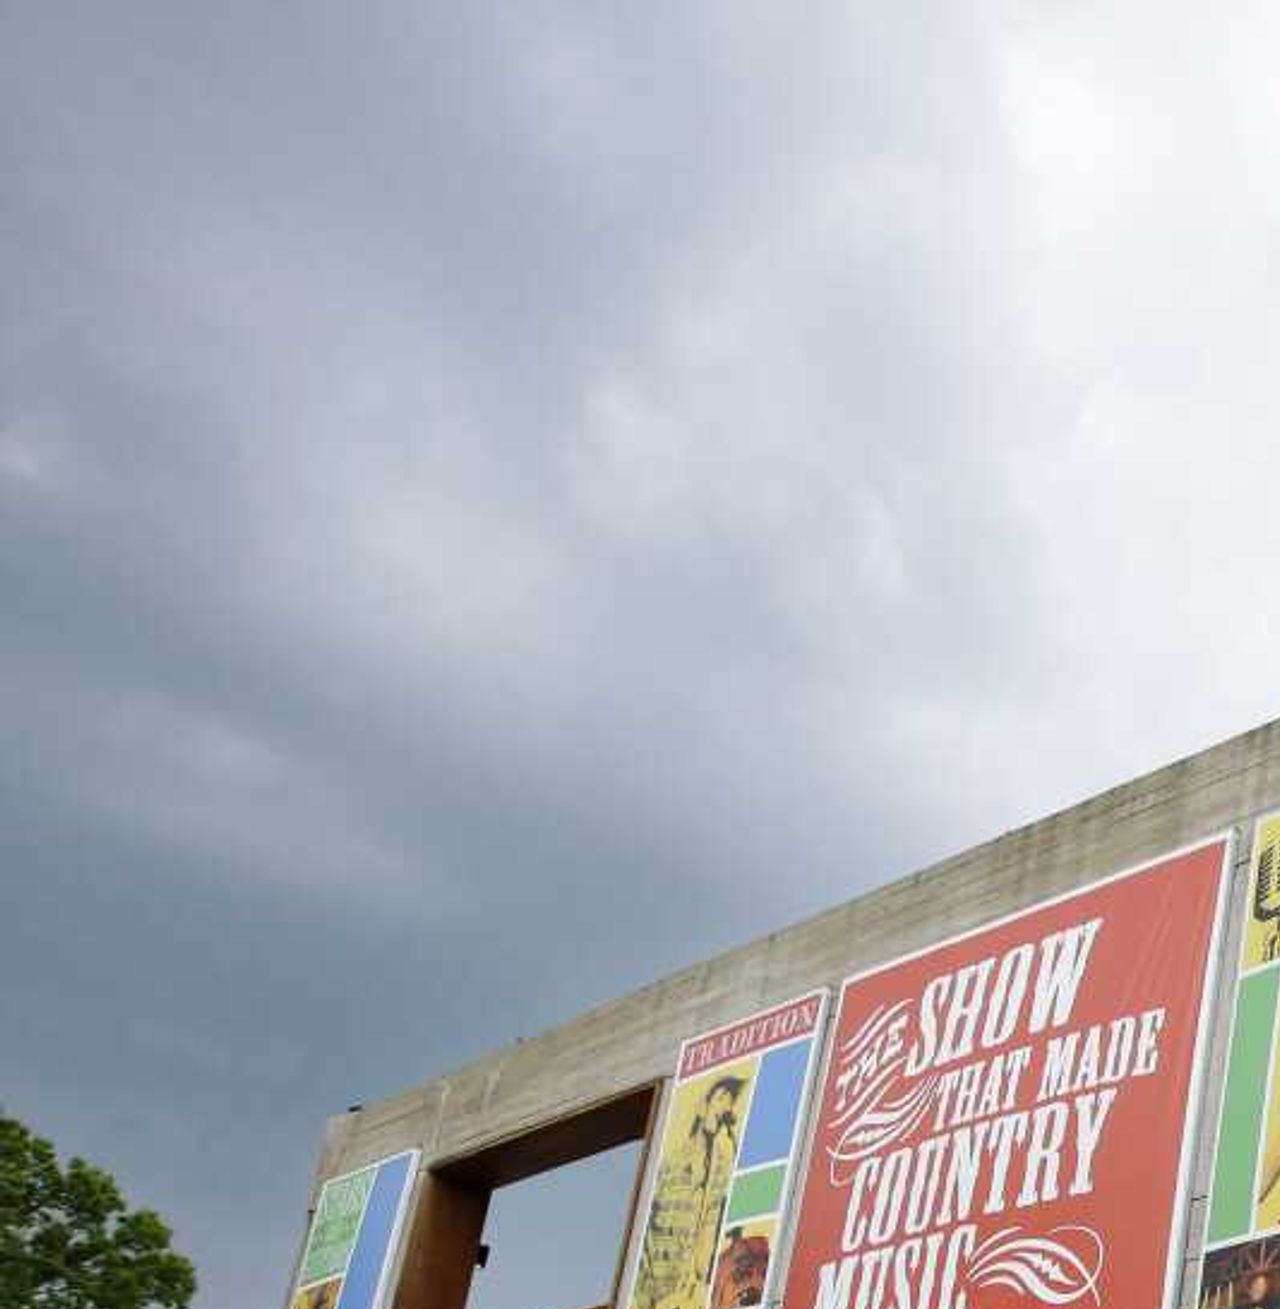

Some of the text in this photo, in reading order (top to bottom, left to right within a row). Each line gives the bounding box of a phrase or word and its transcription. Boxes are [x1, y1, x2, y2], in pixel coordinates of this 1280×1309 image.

[685, 1000, 818, 1072] TRADITION
[904, 918, 1104, 1077] SHOW
[931, 1008, 1168, 1131] THAT MADE
[841, 1086, 1118, 1252] COUNTRY
